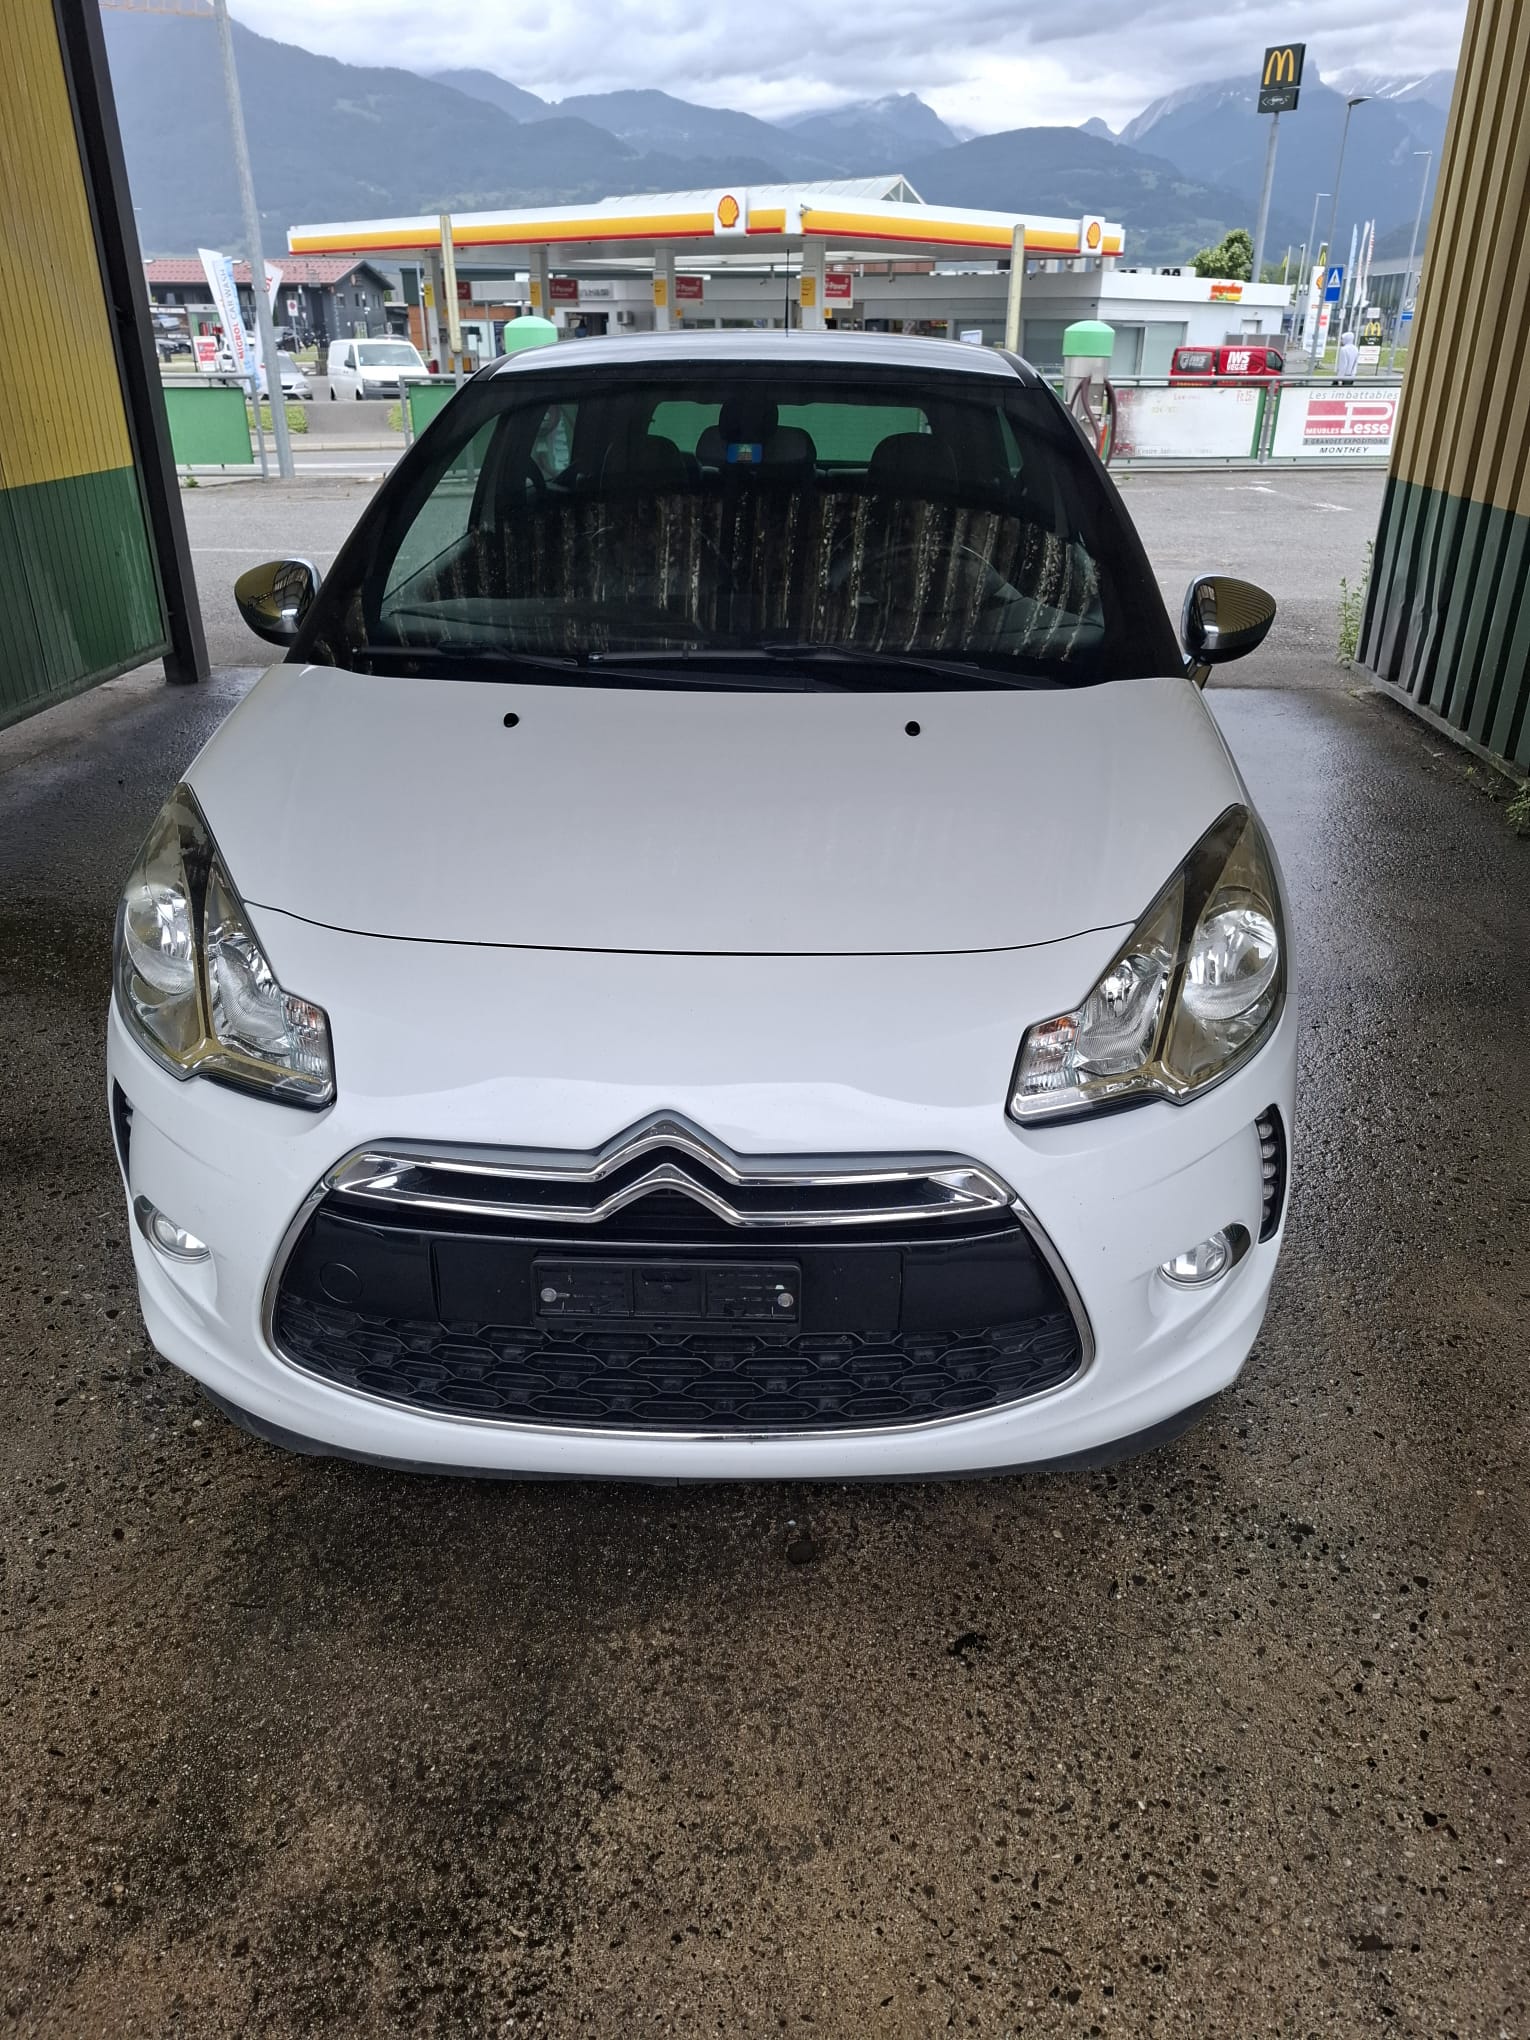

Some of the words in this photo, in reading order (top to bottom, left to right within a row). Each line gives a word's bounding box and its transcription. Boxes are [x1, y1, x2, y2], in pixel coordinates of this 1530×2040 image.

[232, 322, 244, 360] MIGROL
[1309, 391, 1327, 399] Les
[1331, 391, 1399, 399] imbattables
